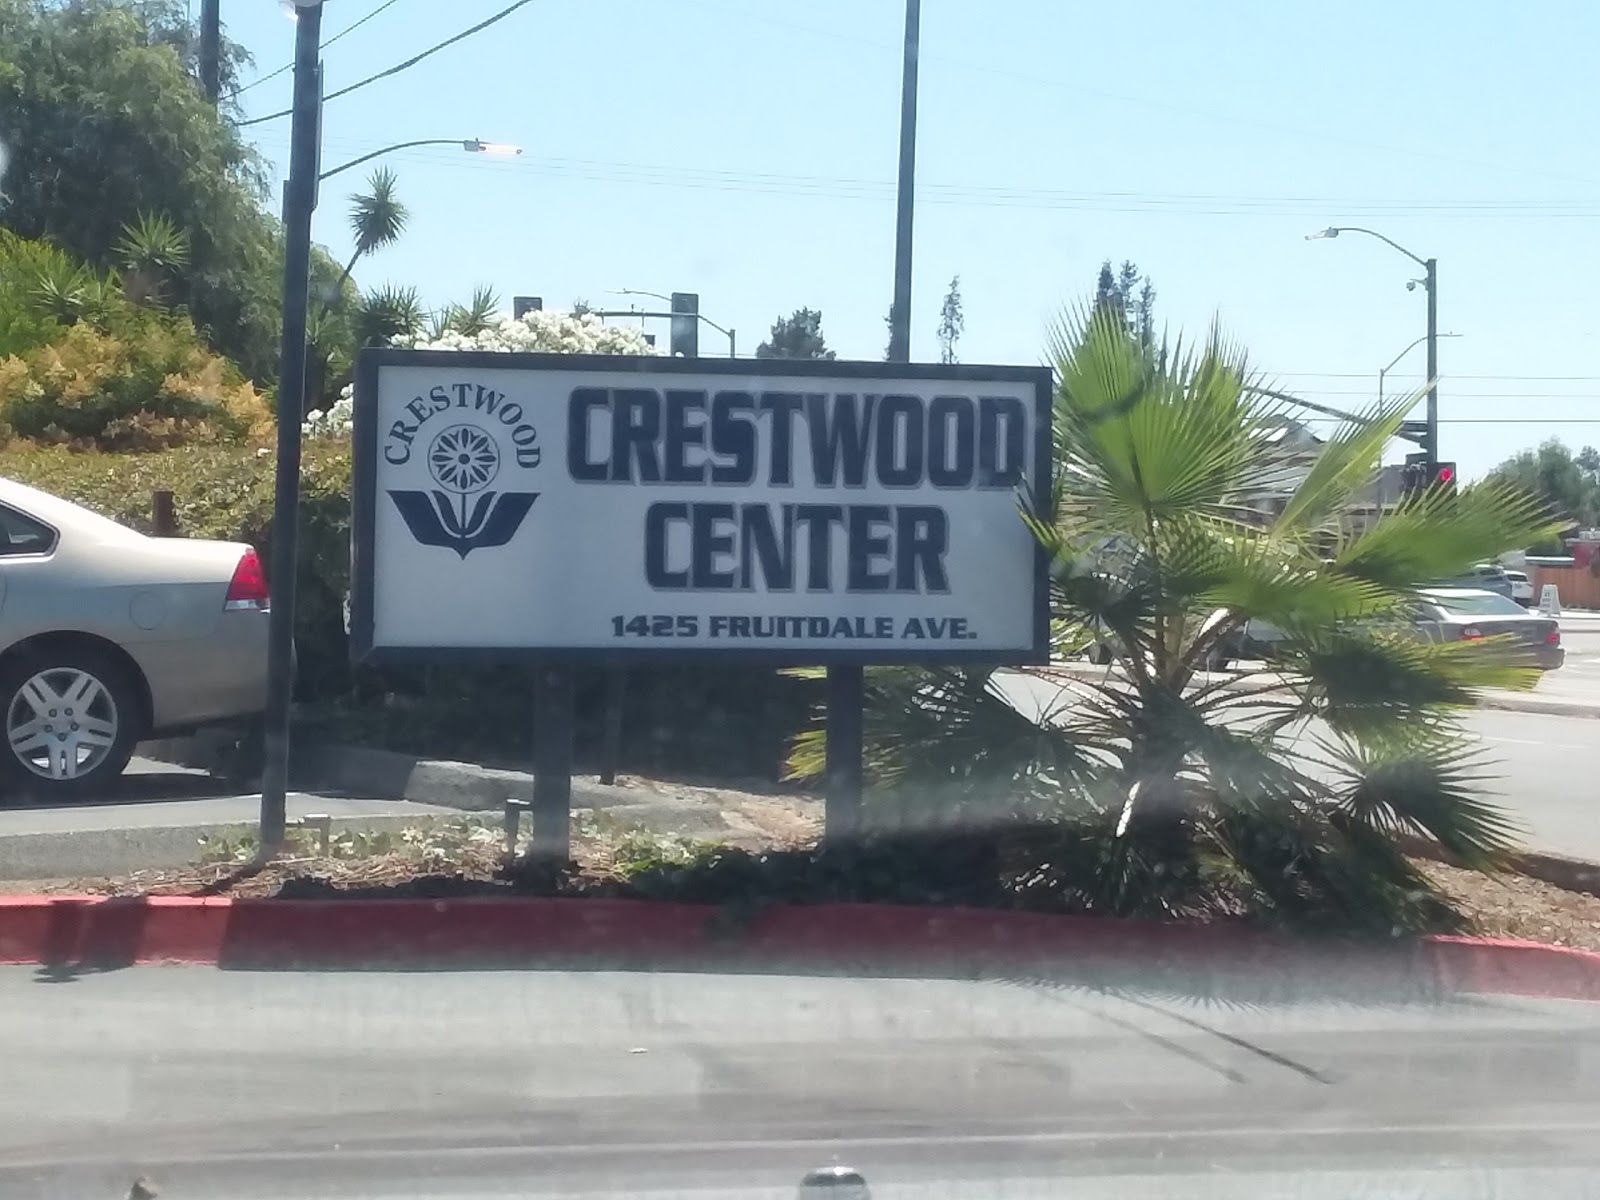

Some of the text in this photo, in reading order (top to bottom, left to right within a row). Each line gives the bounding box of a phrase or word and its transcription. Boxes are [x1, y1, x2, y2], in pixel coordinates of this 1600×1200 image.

[384, 383, 541, 469] CRESTWOOD
[567, 386, 1027, 489] CRESTWOOD
[644, 502, 951, 594] CENTER
[611, 615, 978, 640] 1425 FRUITDALE AVE.
